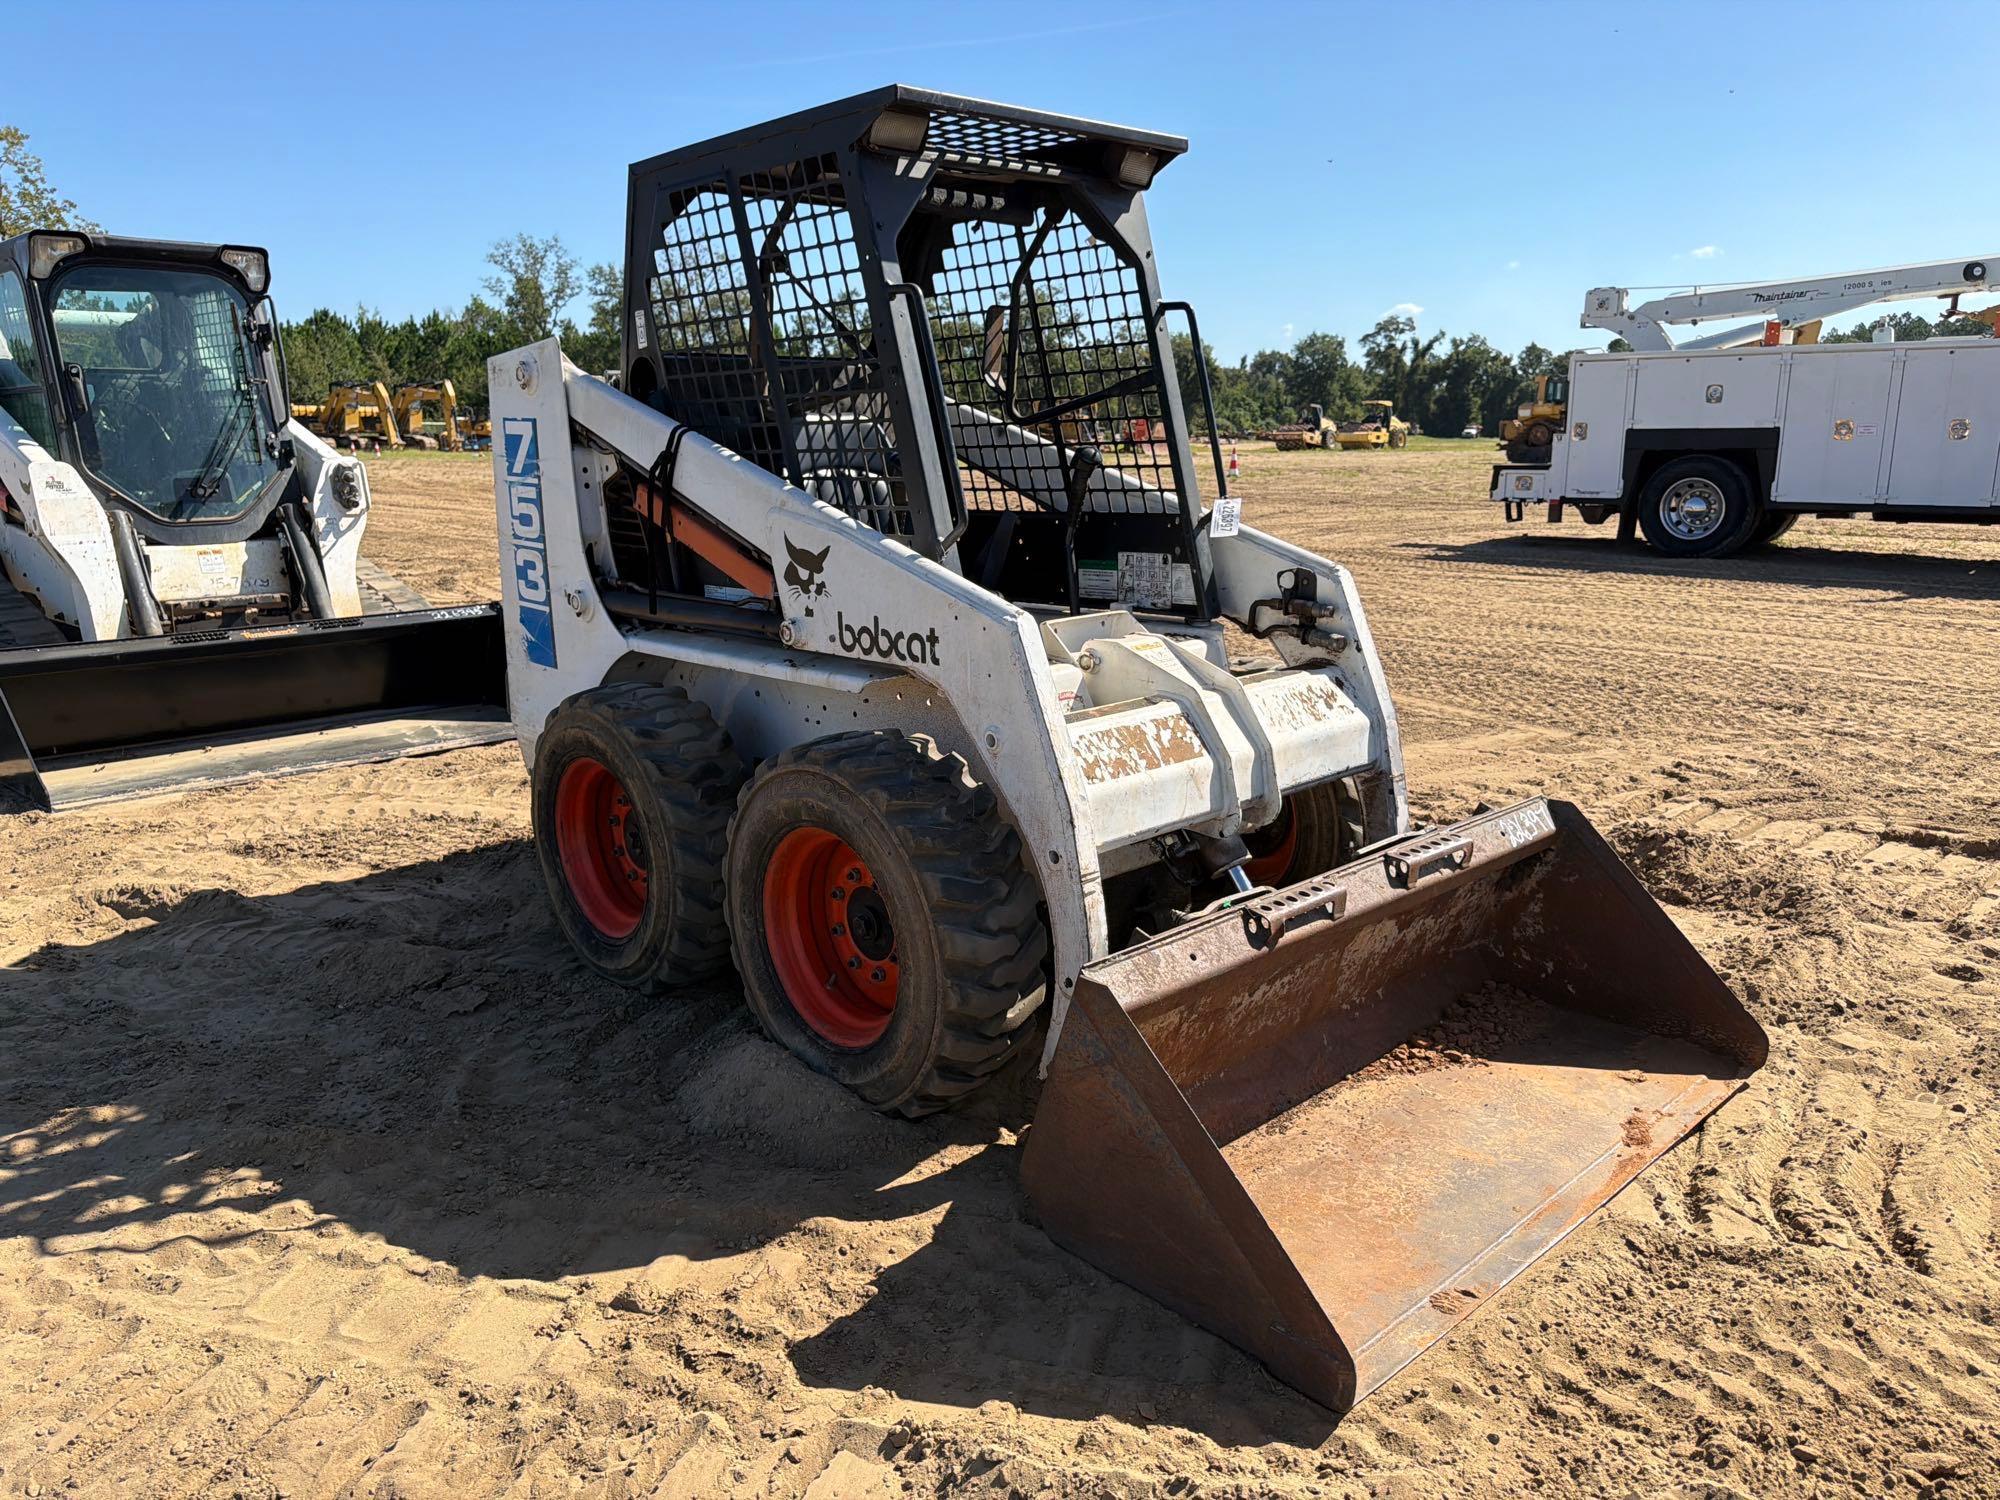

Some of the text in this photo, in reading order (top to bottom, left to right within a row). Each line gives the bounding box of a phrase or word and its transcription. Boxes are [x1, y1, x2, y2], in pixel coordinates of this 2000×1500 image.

[1746, 289, 1819, 303] Maintainer
[1843, 281, 1867, 290] 12000
[504, 420, 548, 602] 753
[1219, 505, 1235, 532] 226397
[837, 611, 940, 666] bobcat
